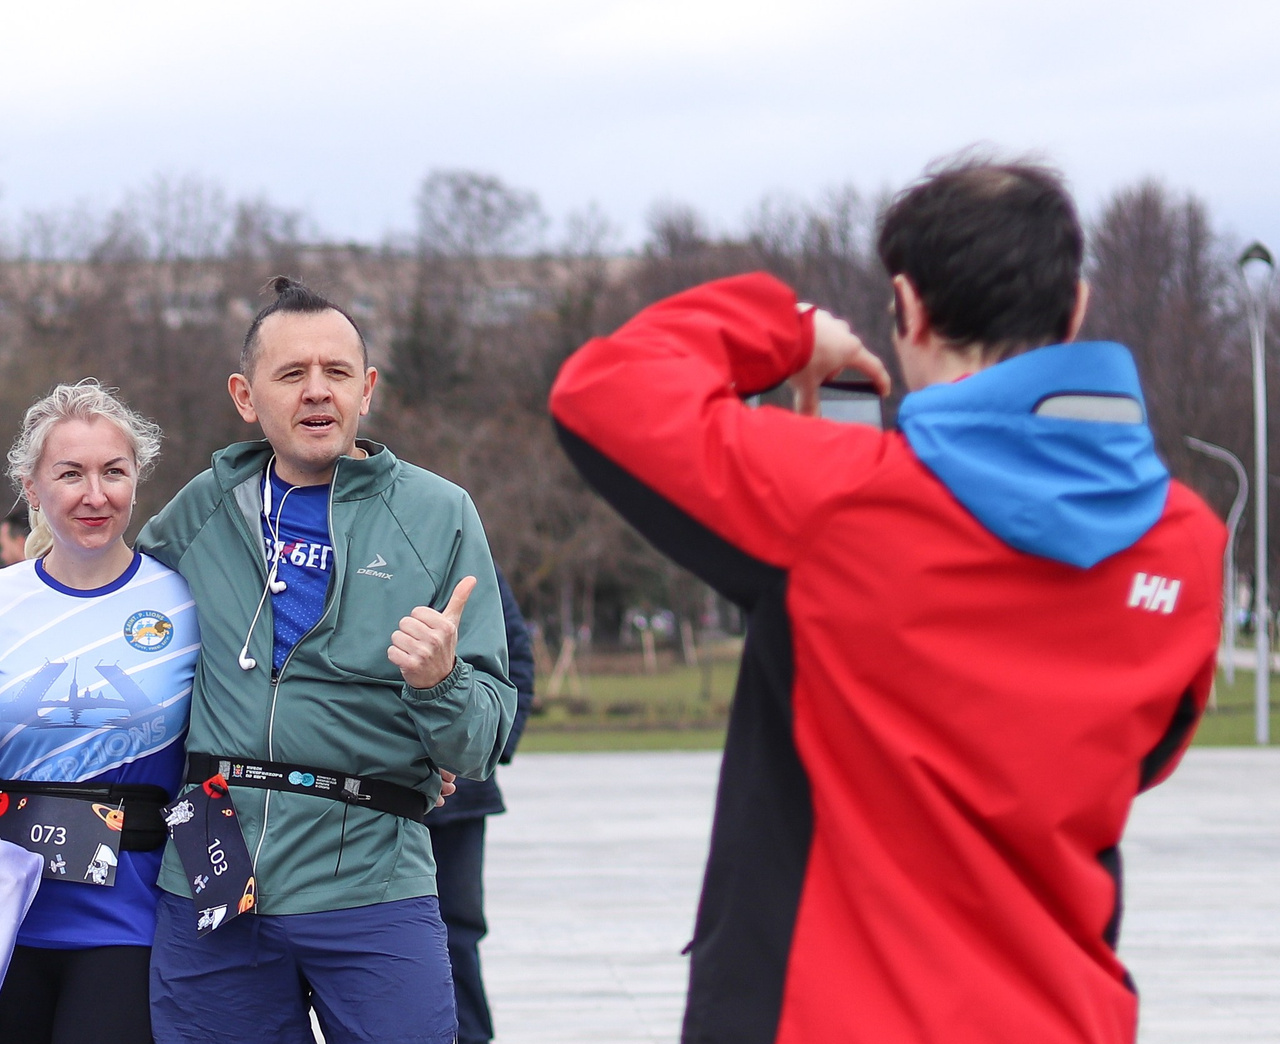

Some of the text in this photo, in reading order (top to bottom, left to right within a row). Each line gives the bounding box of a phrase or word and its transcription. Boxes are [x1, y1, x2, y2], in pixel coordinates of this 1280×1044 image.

[356, 568, 393, 580] DEMIX
[1127, 572, 1181, 614] HH
[30, 824, 67, 846] 073
[207, 838, 229, 876] 103
